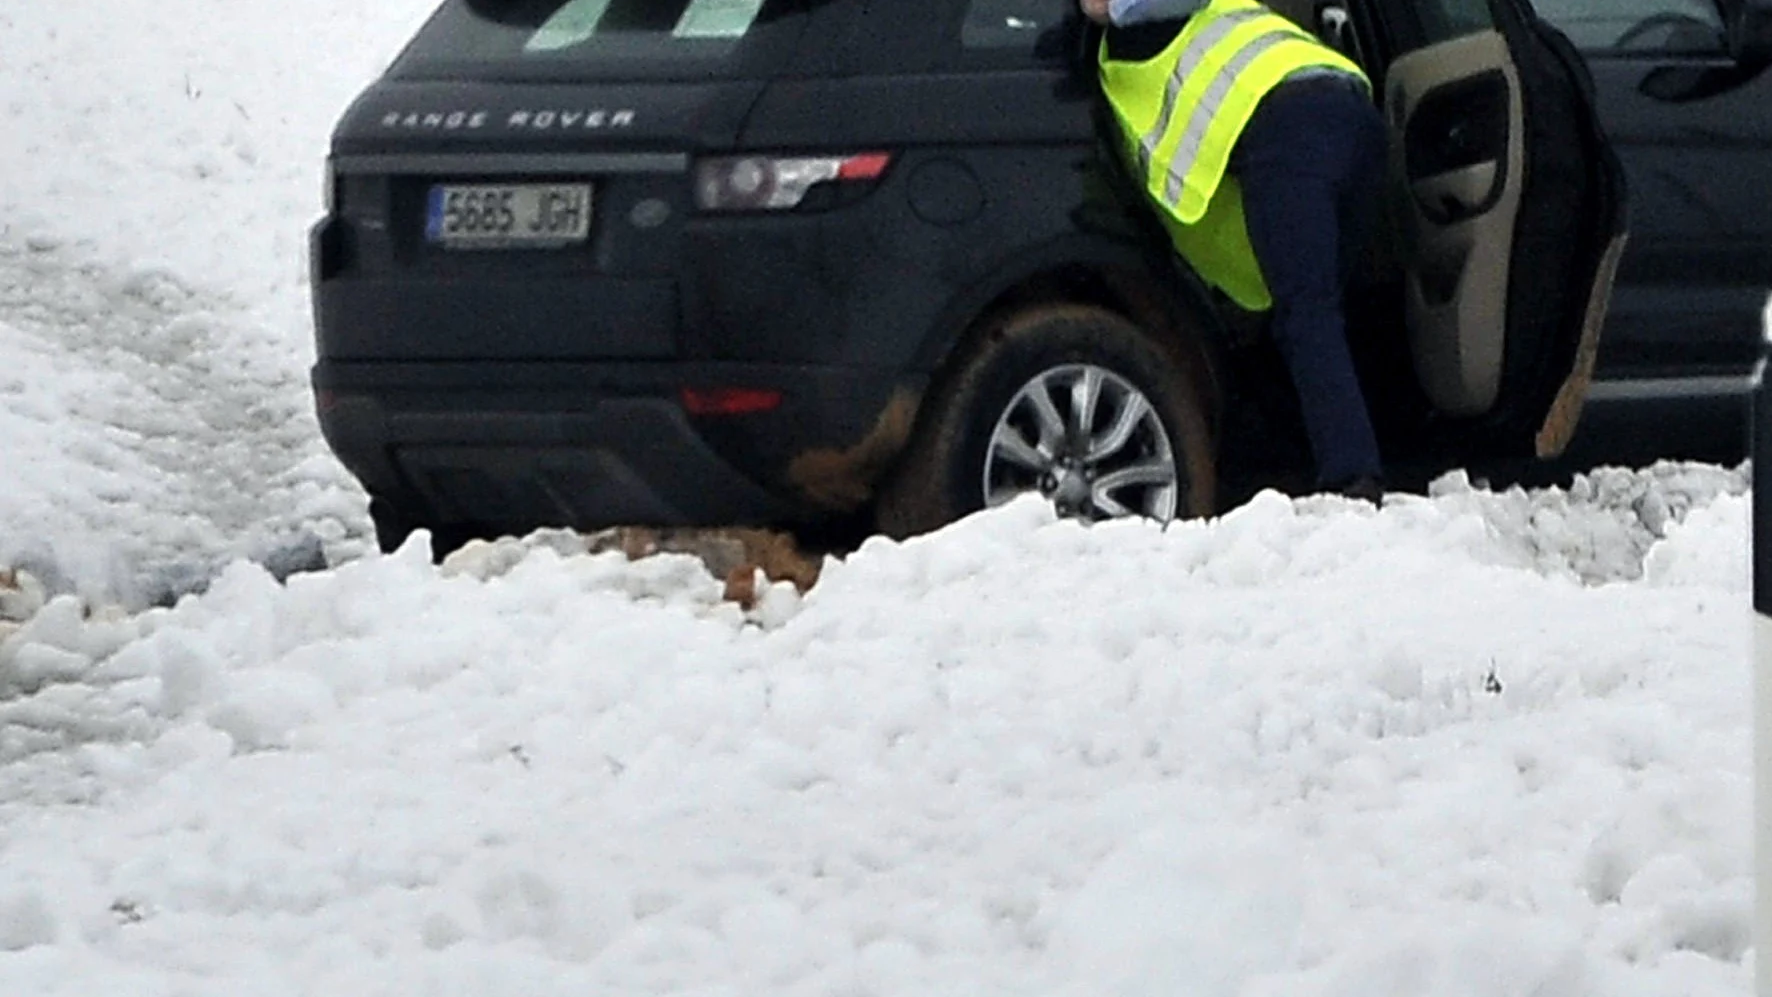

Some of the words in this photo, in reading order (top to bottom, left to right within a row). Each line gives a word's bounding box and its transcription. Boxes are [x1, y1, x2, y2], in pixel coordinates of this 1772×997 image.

[381, 110, 488, 130] RANGE
[507, 109, 635, 130] ROVER
[447, 187, 515, 233] 5685
[528, 188, 583, 232] JGH
